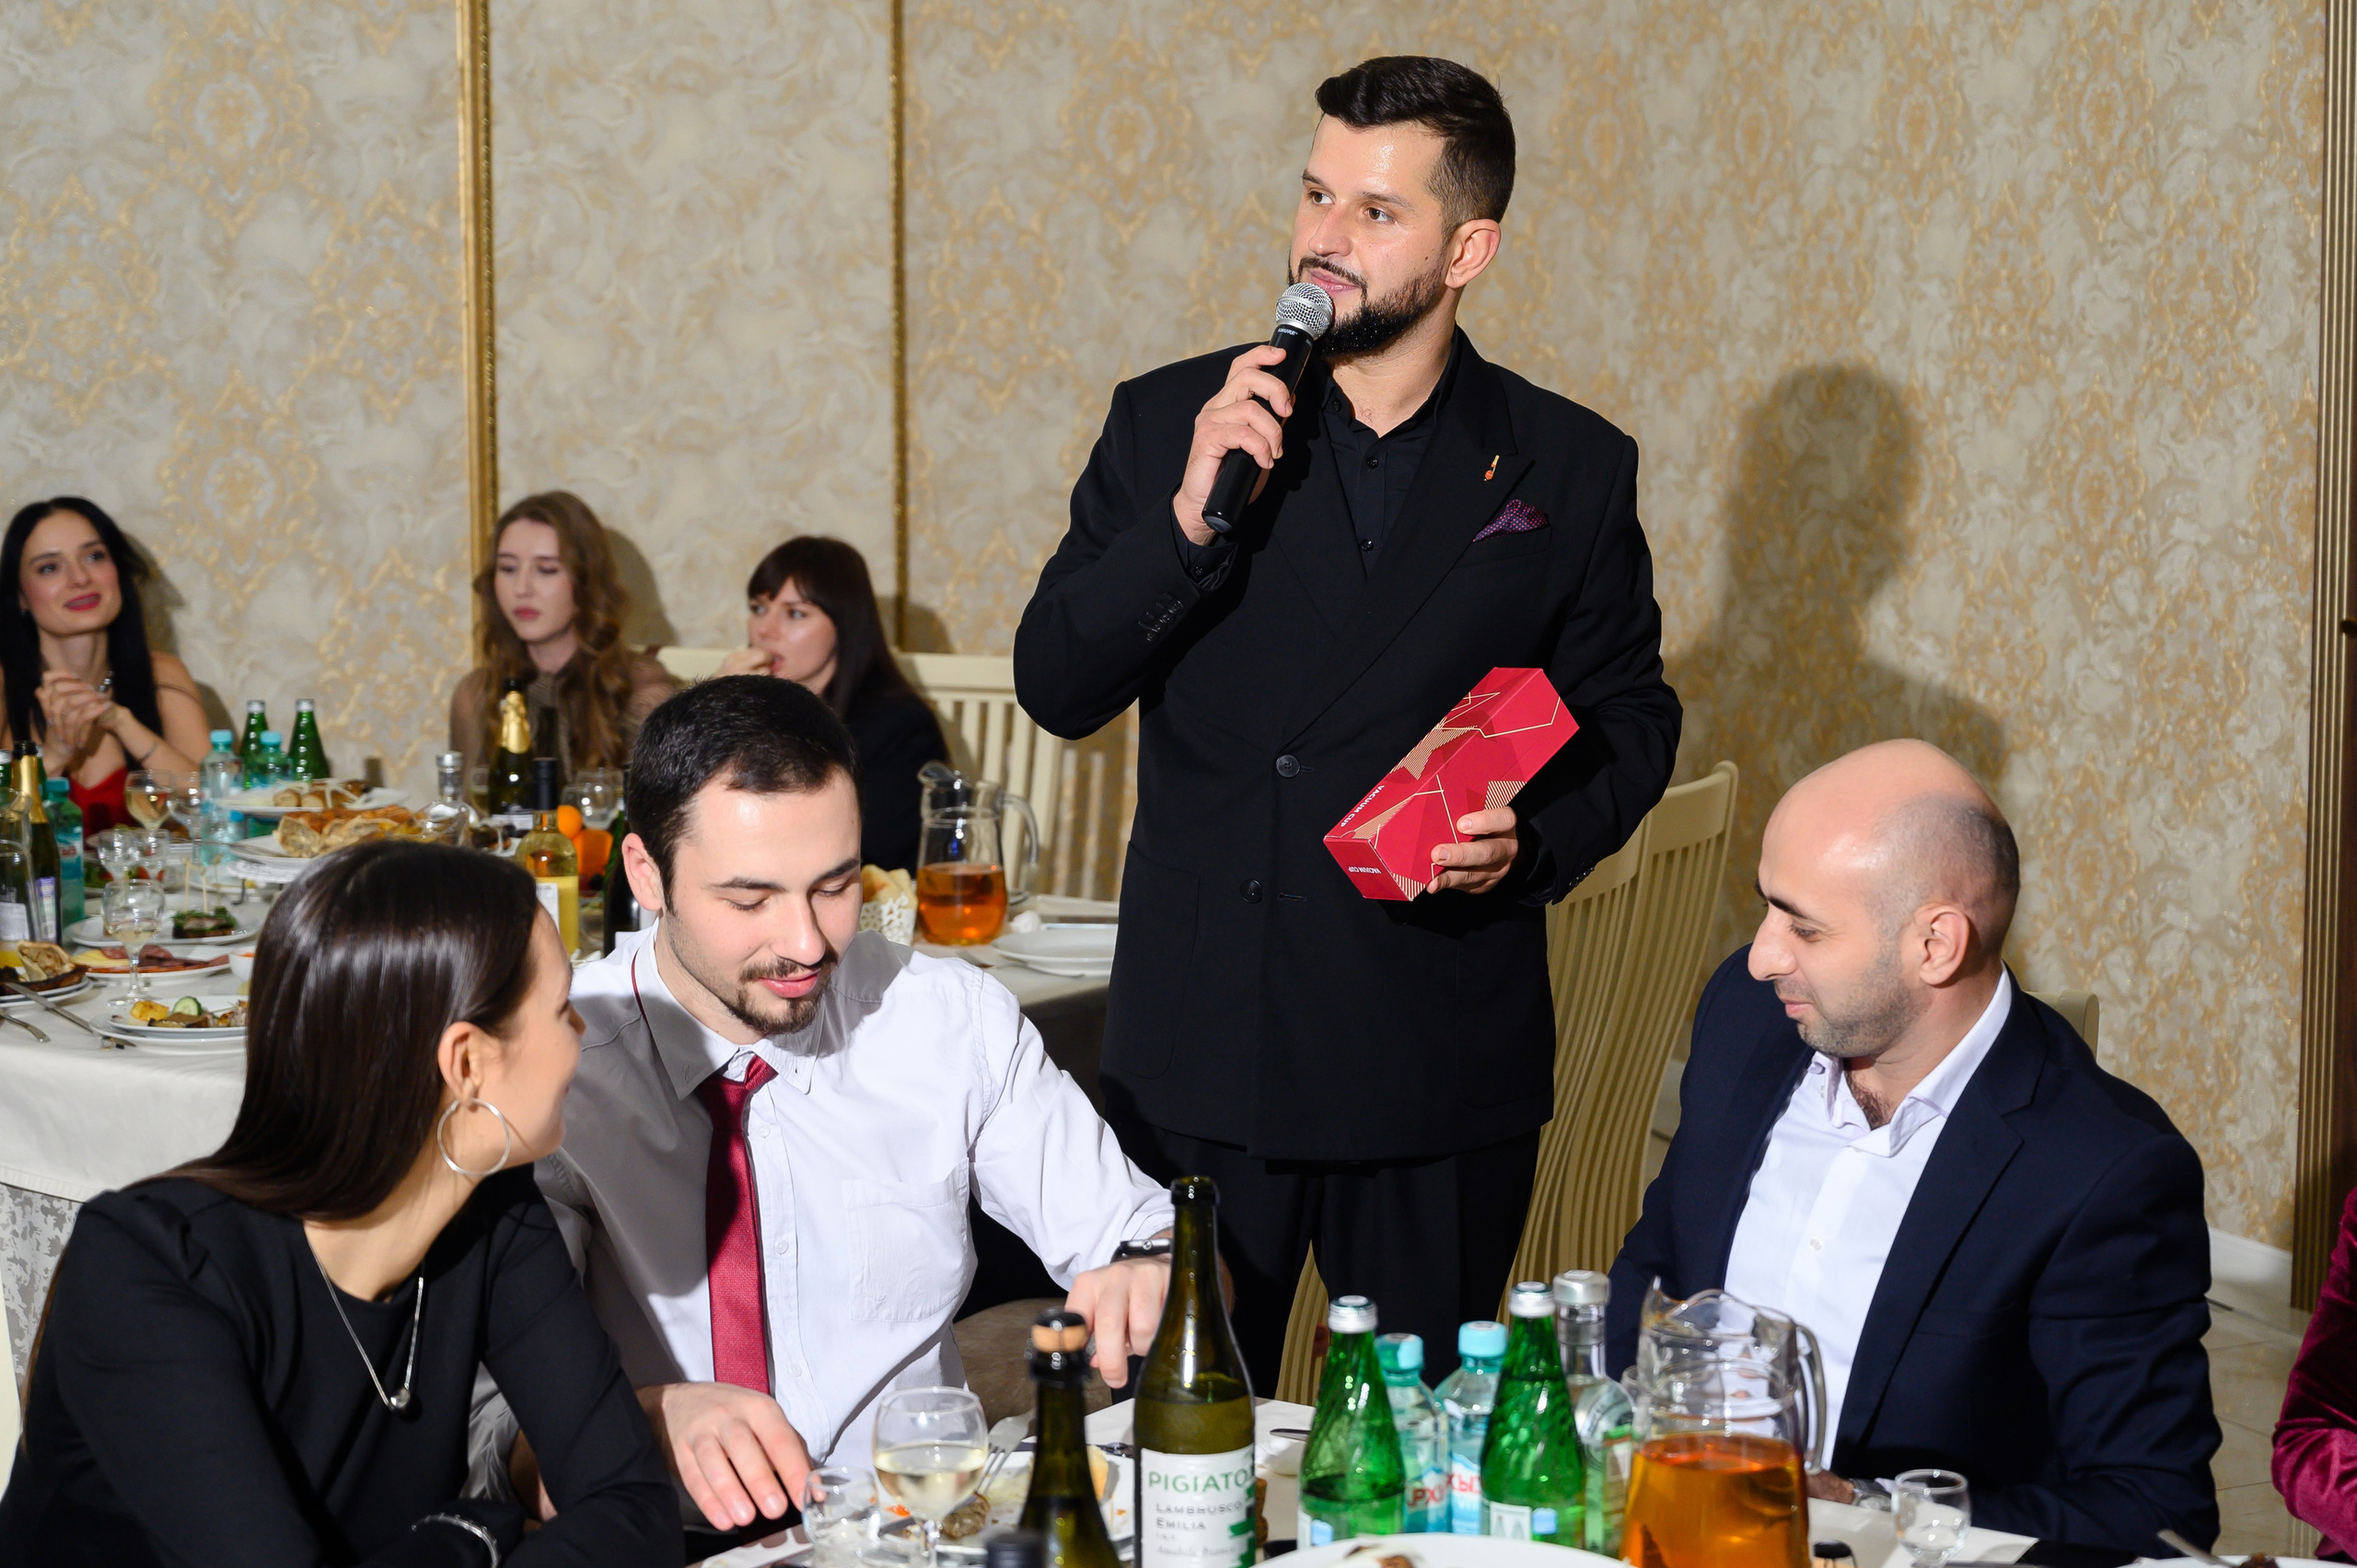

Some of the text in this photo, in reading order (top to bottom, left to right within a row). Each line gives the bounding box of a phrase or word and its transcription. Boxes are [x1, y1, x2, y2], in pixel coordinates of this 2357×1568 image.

[1341, 784, 1385, 828] VACUUM CUP
[1358, 866, 1382, 875] VACUUM
[1148, 1469, 1249, 1493] PIGIATO
[1155, 1501, 1242, 1515] LAMBRUSCO
[1156, 1516, 1206, 1529] EMILIA
